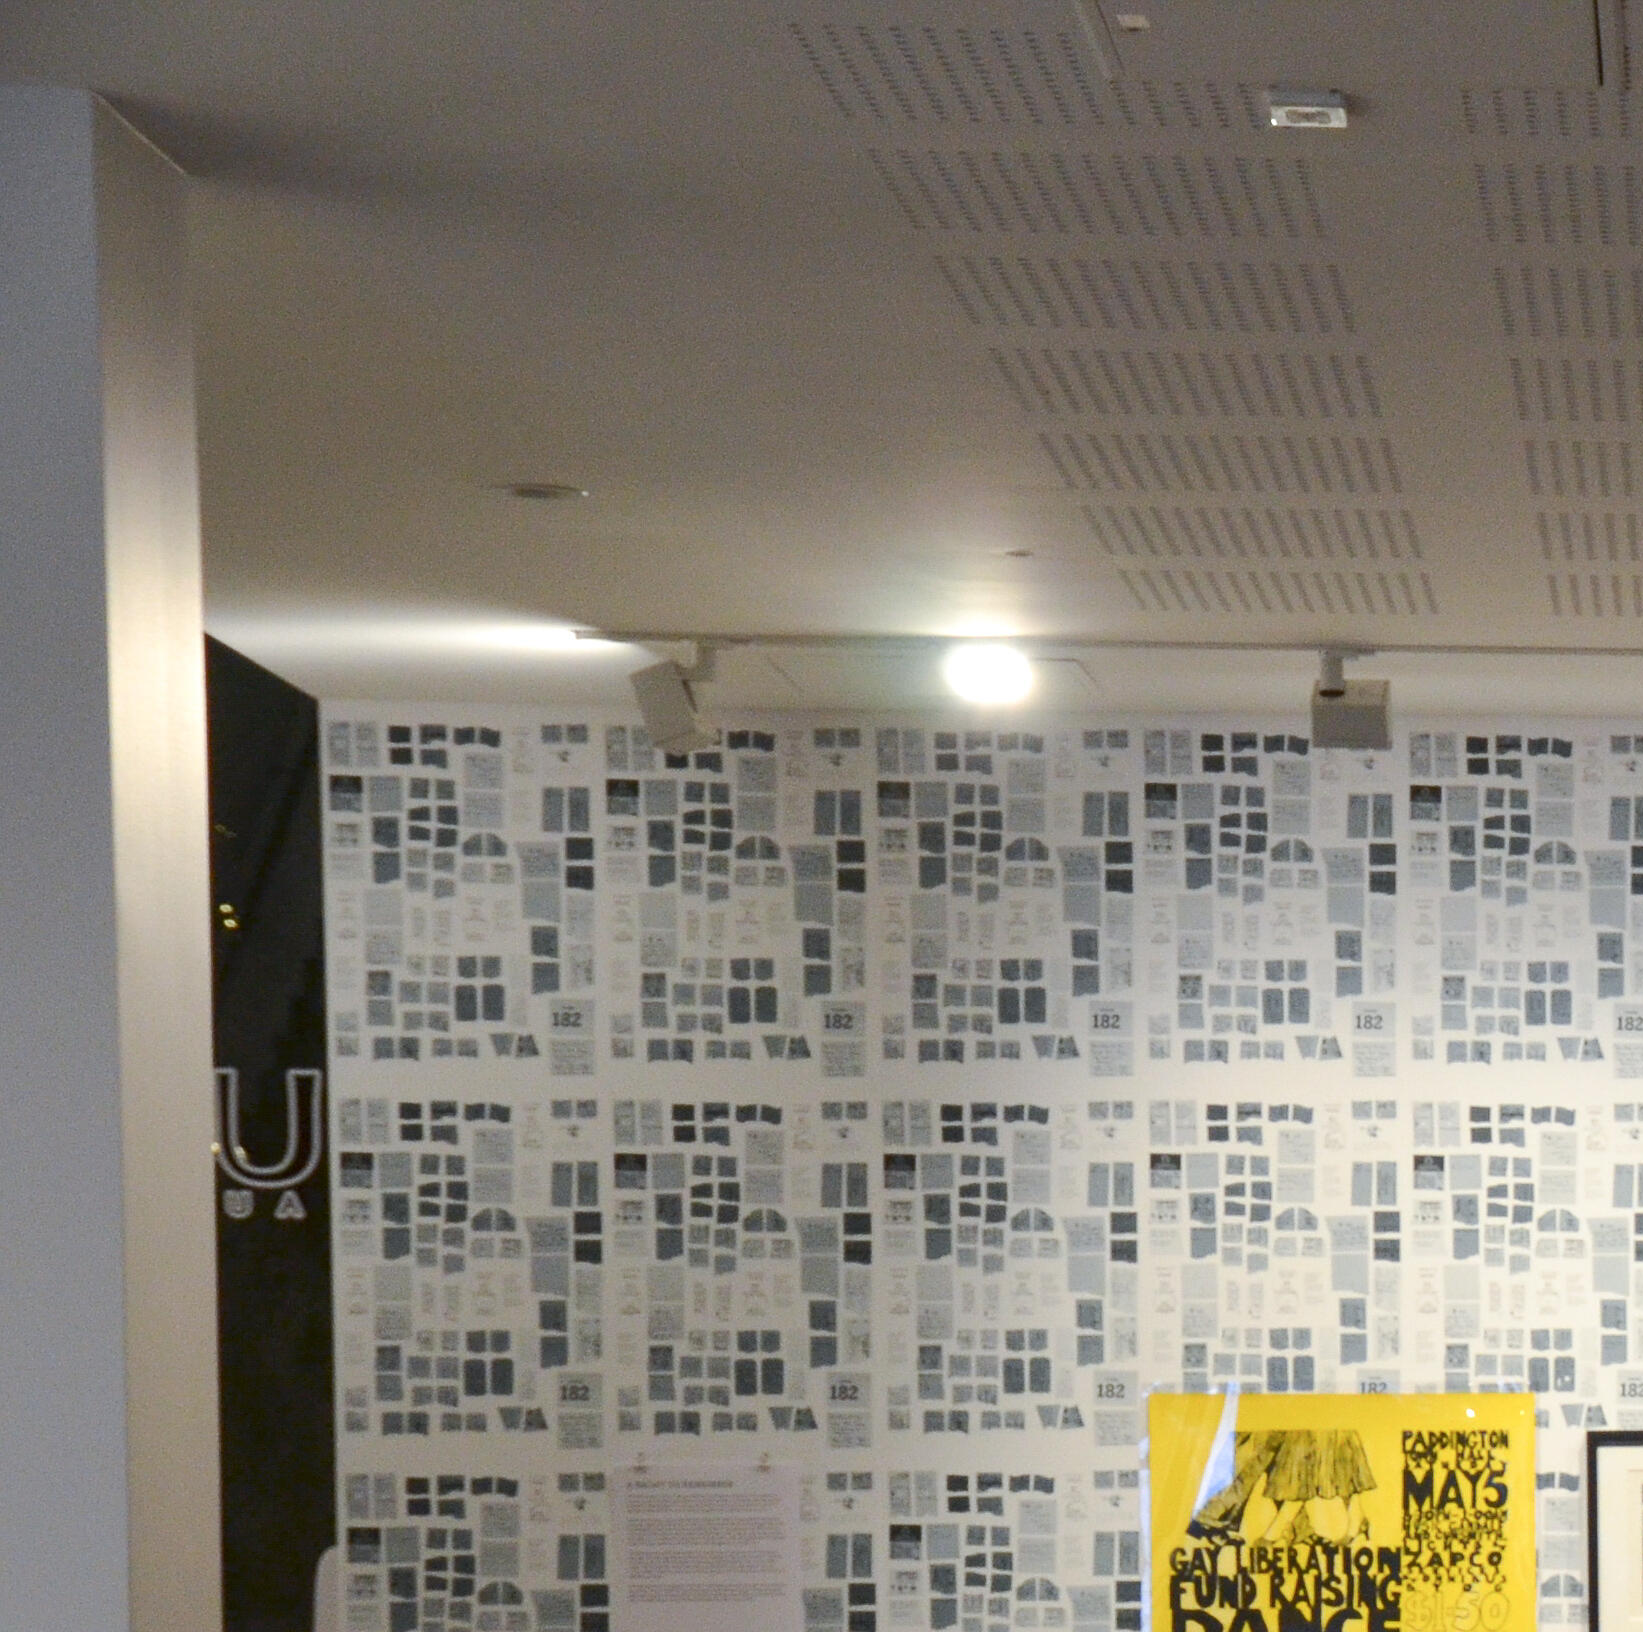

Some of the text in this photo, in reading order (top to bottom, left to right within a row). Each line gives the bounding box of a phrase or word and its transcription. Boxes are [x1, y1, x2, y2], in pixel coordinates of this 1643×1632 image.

[553, 1012, 582, 1028] 182
[824, 1013, 853, 1029] 182
[1092, 1014, 1120, 1030] 182
[1355, 1015, 1383, 1031] 182
[1616, 1016, 1643, 1032] 182
[561, 1385, 590, 1401] 182
[830, 1385, 859, 1401] 182
[1097, 1383, 1125, 1399] 182
[1402, 1430, 1509, 1454] PADDINGTON
[1402, 1462, 1509, 1511] MAY 5
[1170, 1546, 1400, 1576] GAY LIBERATION
[1170, 1574, 1258, 1609] FUND
[1269, 1573, 1401, 1610] RAISING
